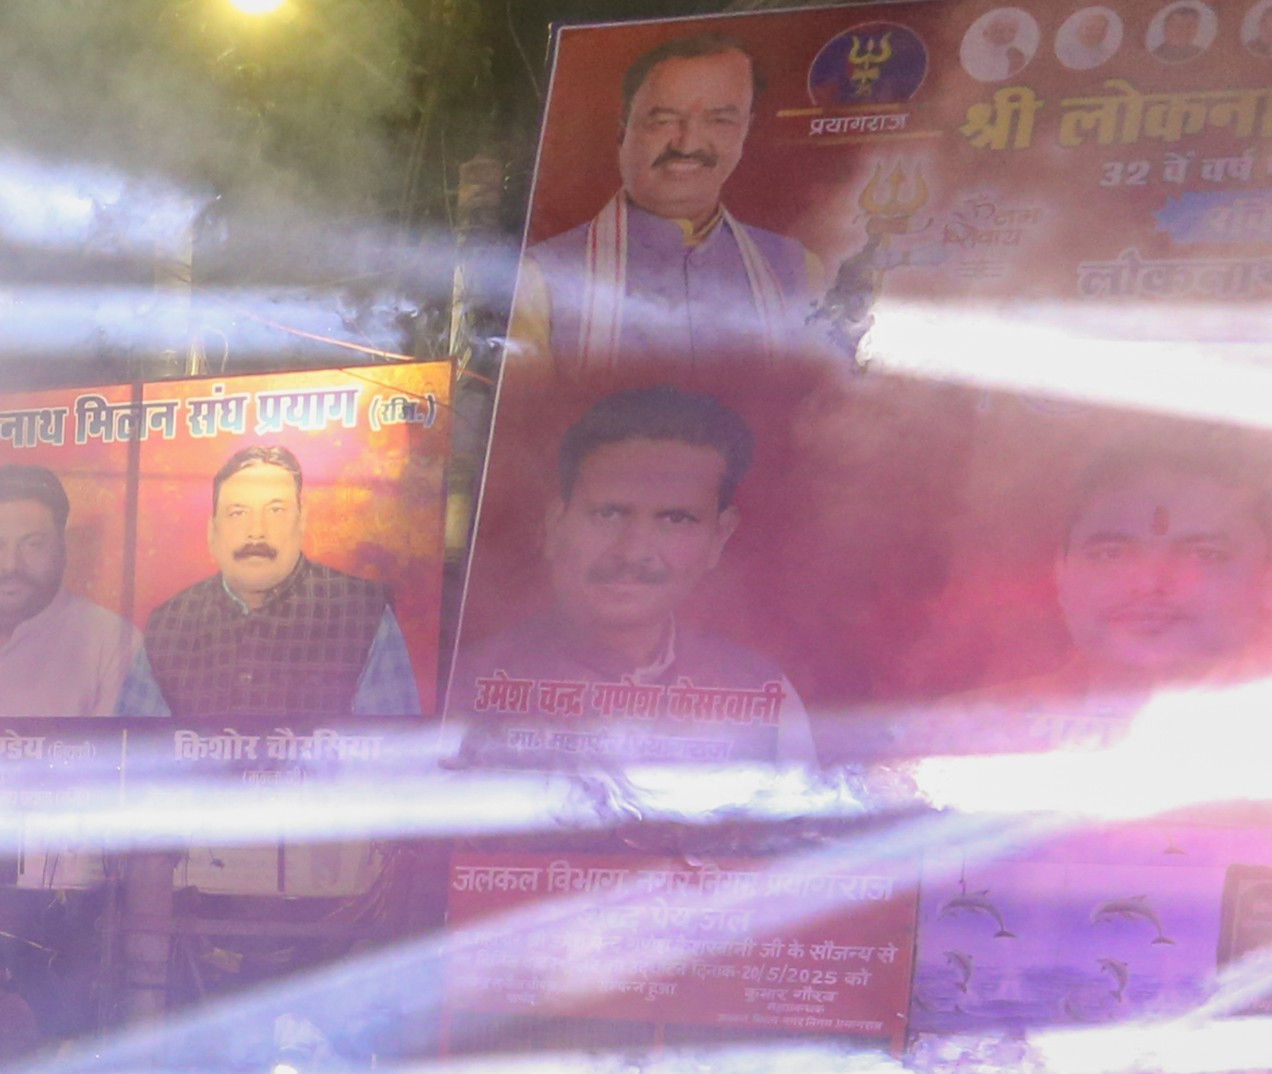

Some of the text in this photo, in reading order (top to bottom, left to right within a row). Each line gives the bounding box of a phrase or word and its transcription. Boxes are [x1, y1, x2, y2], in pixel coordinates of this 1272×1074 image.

[808, 112, 910, 137] प्रयागराज
[959, 79, 1272, 150] श्री लोकना
[1098, 160, 1150, 187] 32
[1201, 147, 1254, 183] वर्ष
[73, 394, 180, 446] मिलन
[185, 383, 250, 438] संघ
[253, 385, 364, 437] प्रयाग
[474, 669, 787, 726] उमेश चन्द्र गणेश केसरवानी
[174, 727, 385, 761] किशोर चौरसिया
[452, 865, 544, 893] जलकल
[761, 873, 897, 902] प्रयागराज
[649, 896, 697, 930] पेय
[699, 907, 759, 933] जल
[759, 938, 787, 959] जी
[787, 940, 807, 960] के
[808, 939, 875, 963] सौजन्य
[876, 942, 899, 964] से
[744, 987, 839, 1003] कुमार गौरव
[843, 969, 872, 987] को
